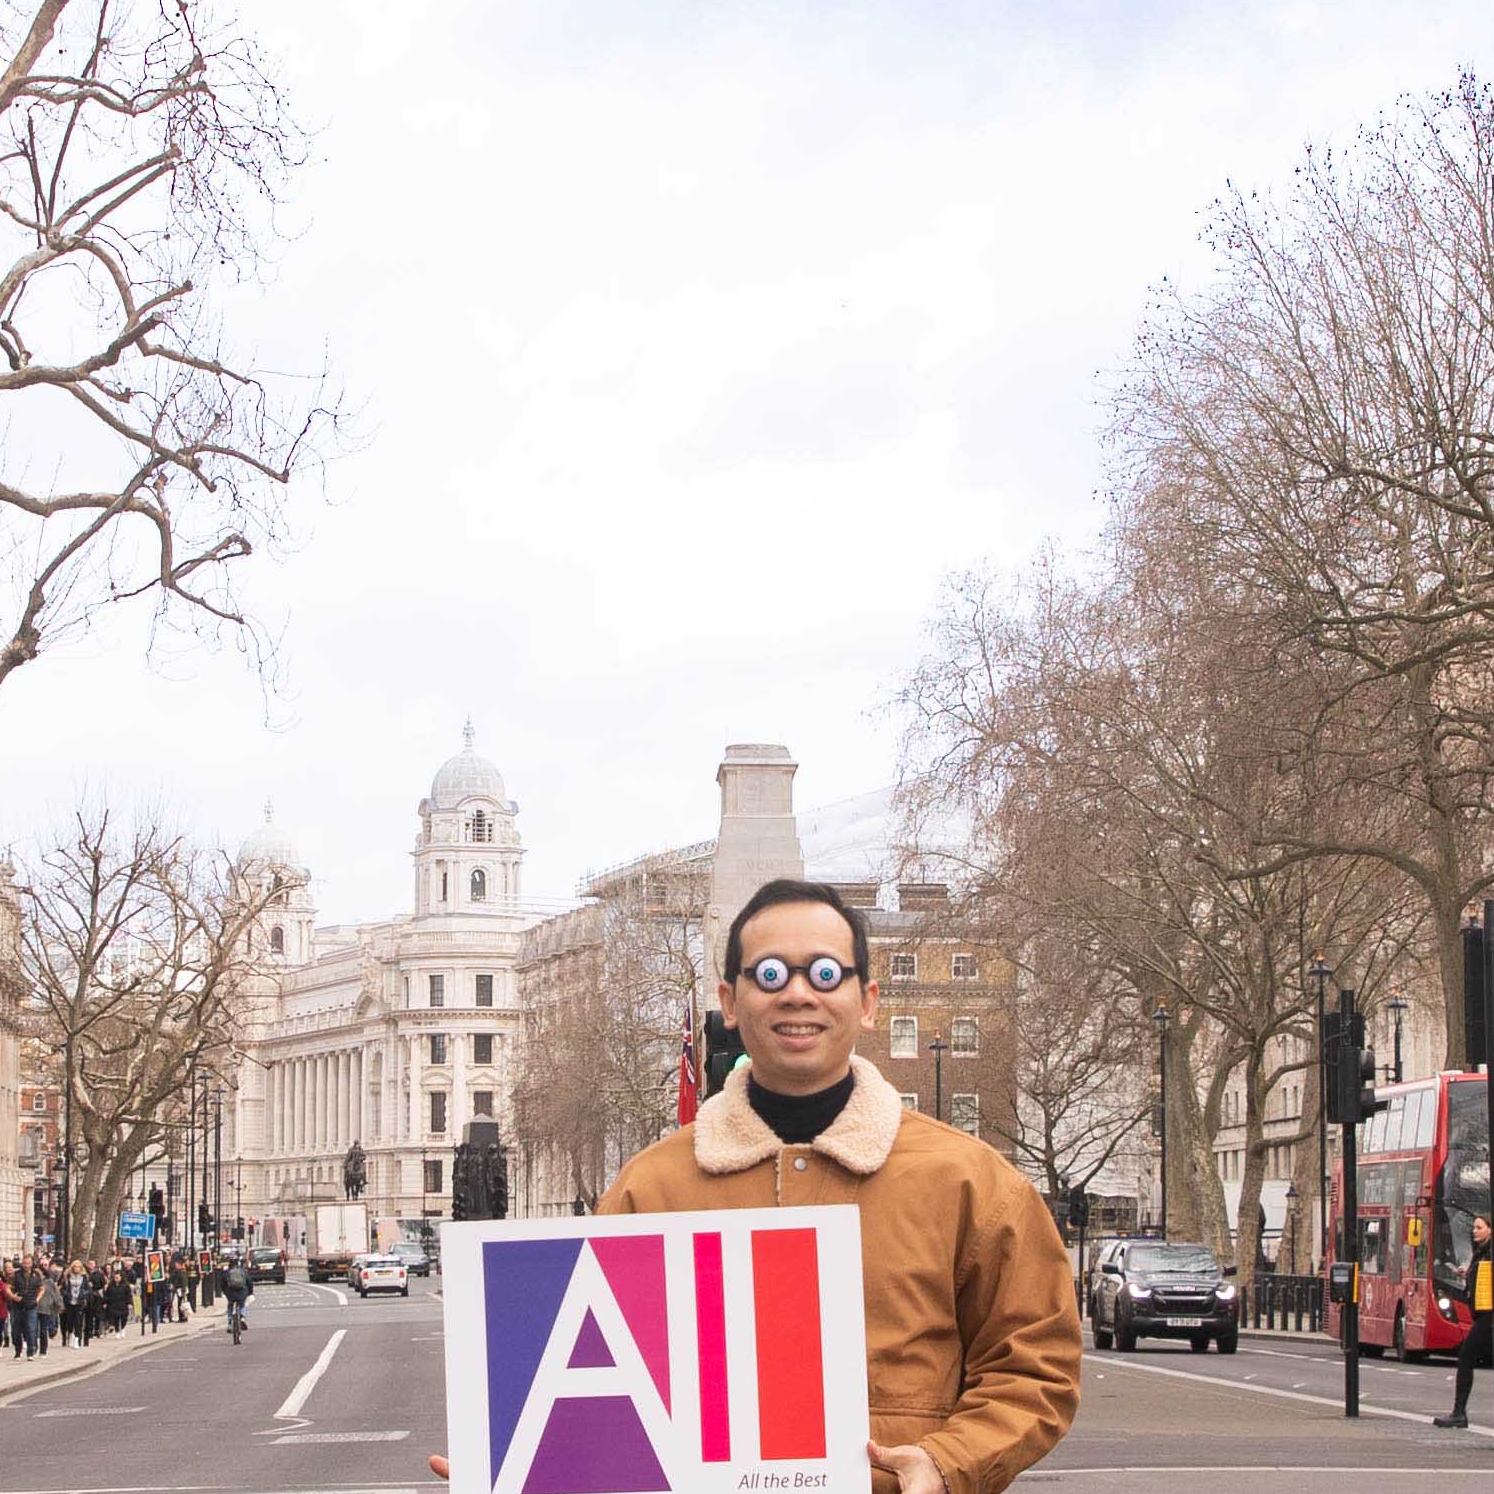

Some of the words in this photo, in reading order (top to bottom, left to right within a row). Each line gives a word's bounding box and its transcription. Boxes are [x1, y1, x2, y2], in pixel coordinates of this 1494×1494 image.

[738, 1473, 761, 1490] All
[764, 1472, 790, 1488] the
[793, 1472, 827, 1488] Best
